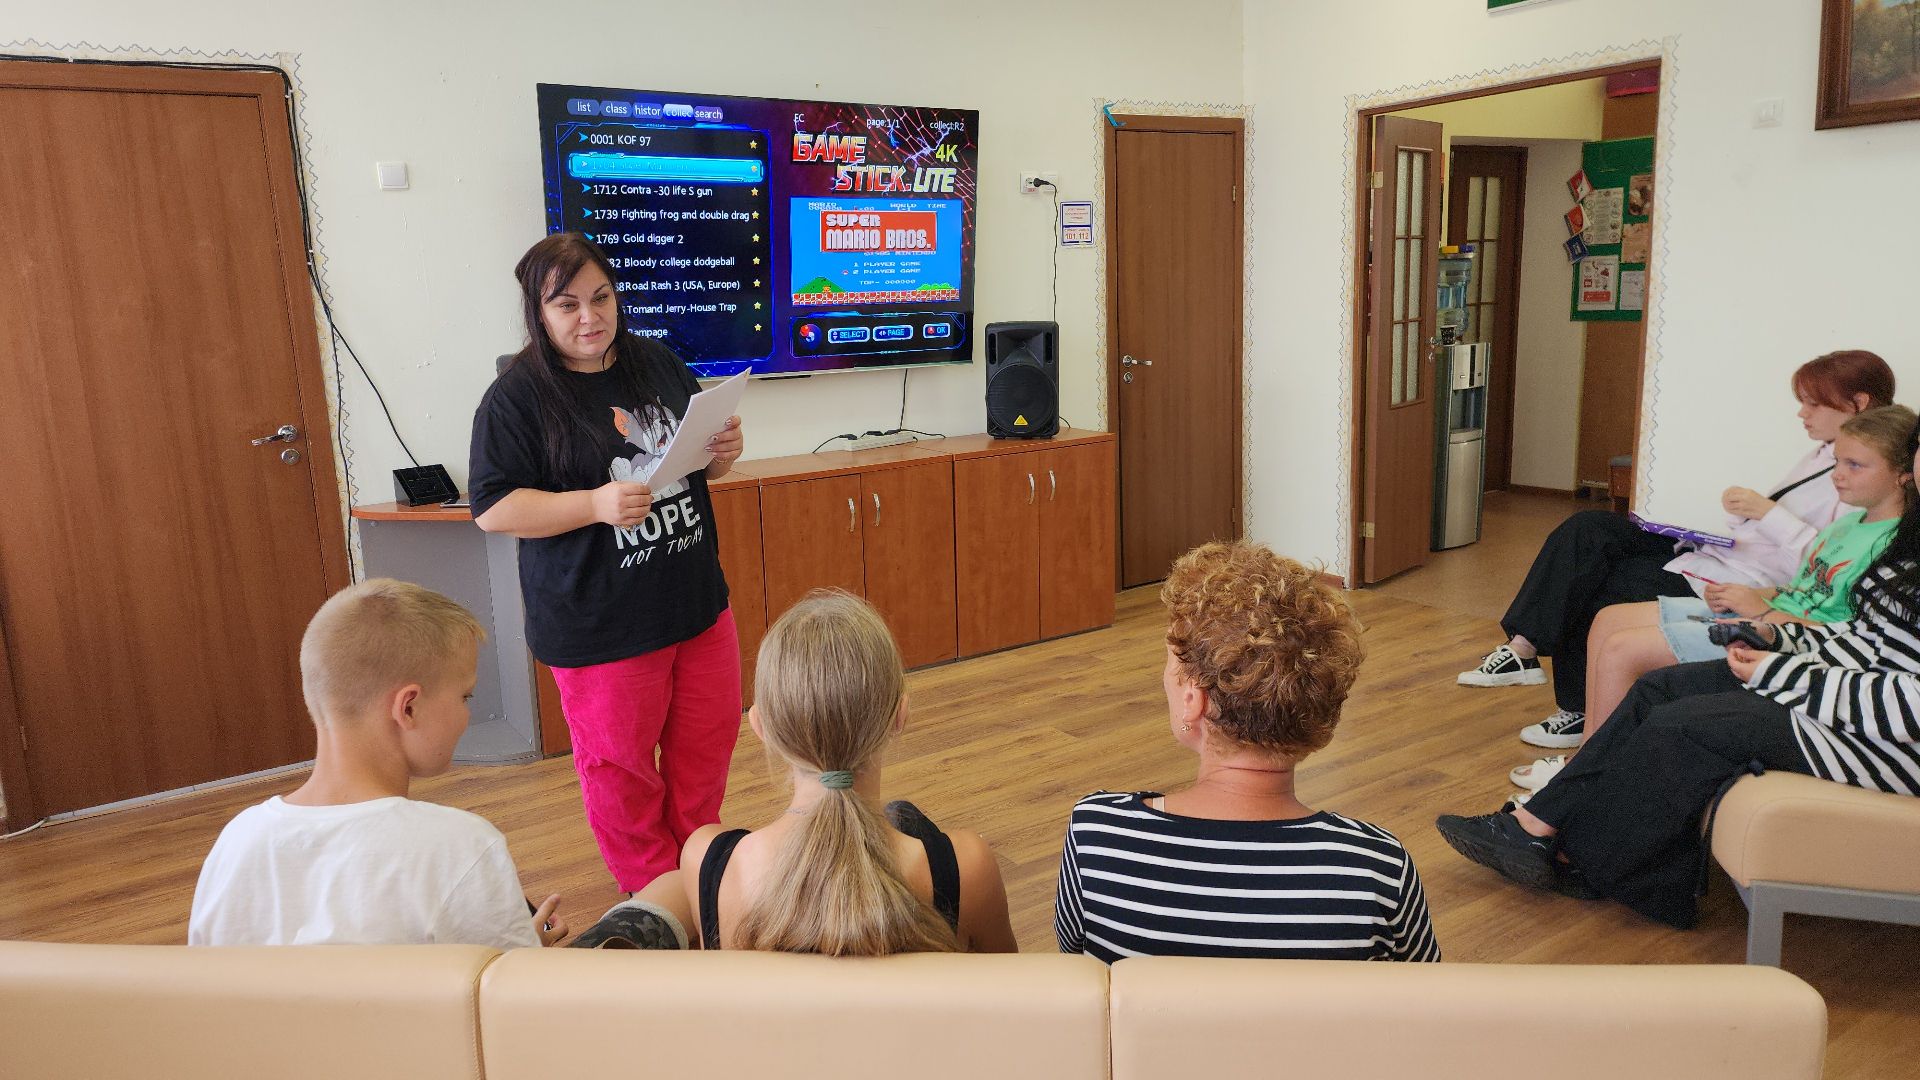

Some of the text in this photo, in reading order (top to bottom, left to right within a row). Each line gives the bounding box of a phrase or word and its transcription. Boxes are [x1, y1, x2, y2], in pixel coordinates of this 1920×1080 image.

[577, 102, 591, 112] list
[606, 103, 627, 114] class
[635, 105, 660, 116] histor
[695, 109, 722, 120] search
[590, 134, 651, 146] 0001 KOF 97
[792, 134, 866, 163] GAME
[936, 144, 958, 162] 4K
[913, 167, 957, 193] LITE
[593, 184, 713, 198] 1712 Contra -30 life S gun
[594, 210, 750, 222] 1739 Fighting frog and double drag
[826, 214, 880, 227] SUPER
[596, 233, 684, 245] 1769 Gold digger 2
[826, 229, 932, 250] MARIO BROS.
[624, 257, 657, 268] Bloody
[660, 257, 691, 268] college
[694, 256, 735, 268] dodgeball
[651, 281, 671, 290] Rash
[674, 281, 680, 290] 3
[682, 280, 705, 292] (USA,
[708, 280, 740, 292] Europe)
[665, 303, 716, 315] Jerry-House
[719, 303, 737, 313] Trap
[839, 330, 866, 339] SELECT
[888, 328, 905, 336] PAGE
[936, 326, 946, 334] OK
[614, 496, 701, 549] NOPE
[620, 525, 703, 569] NOT TODAY
